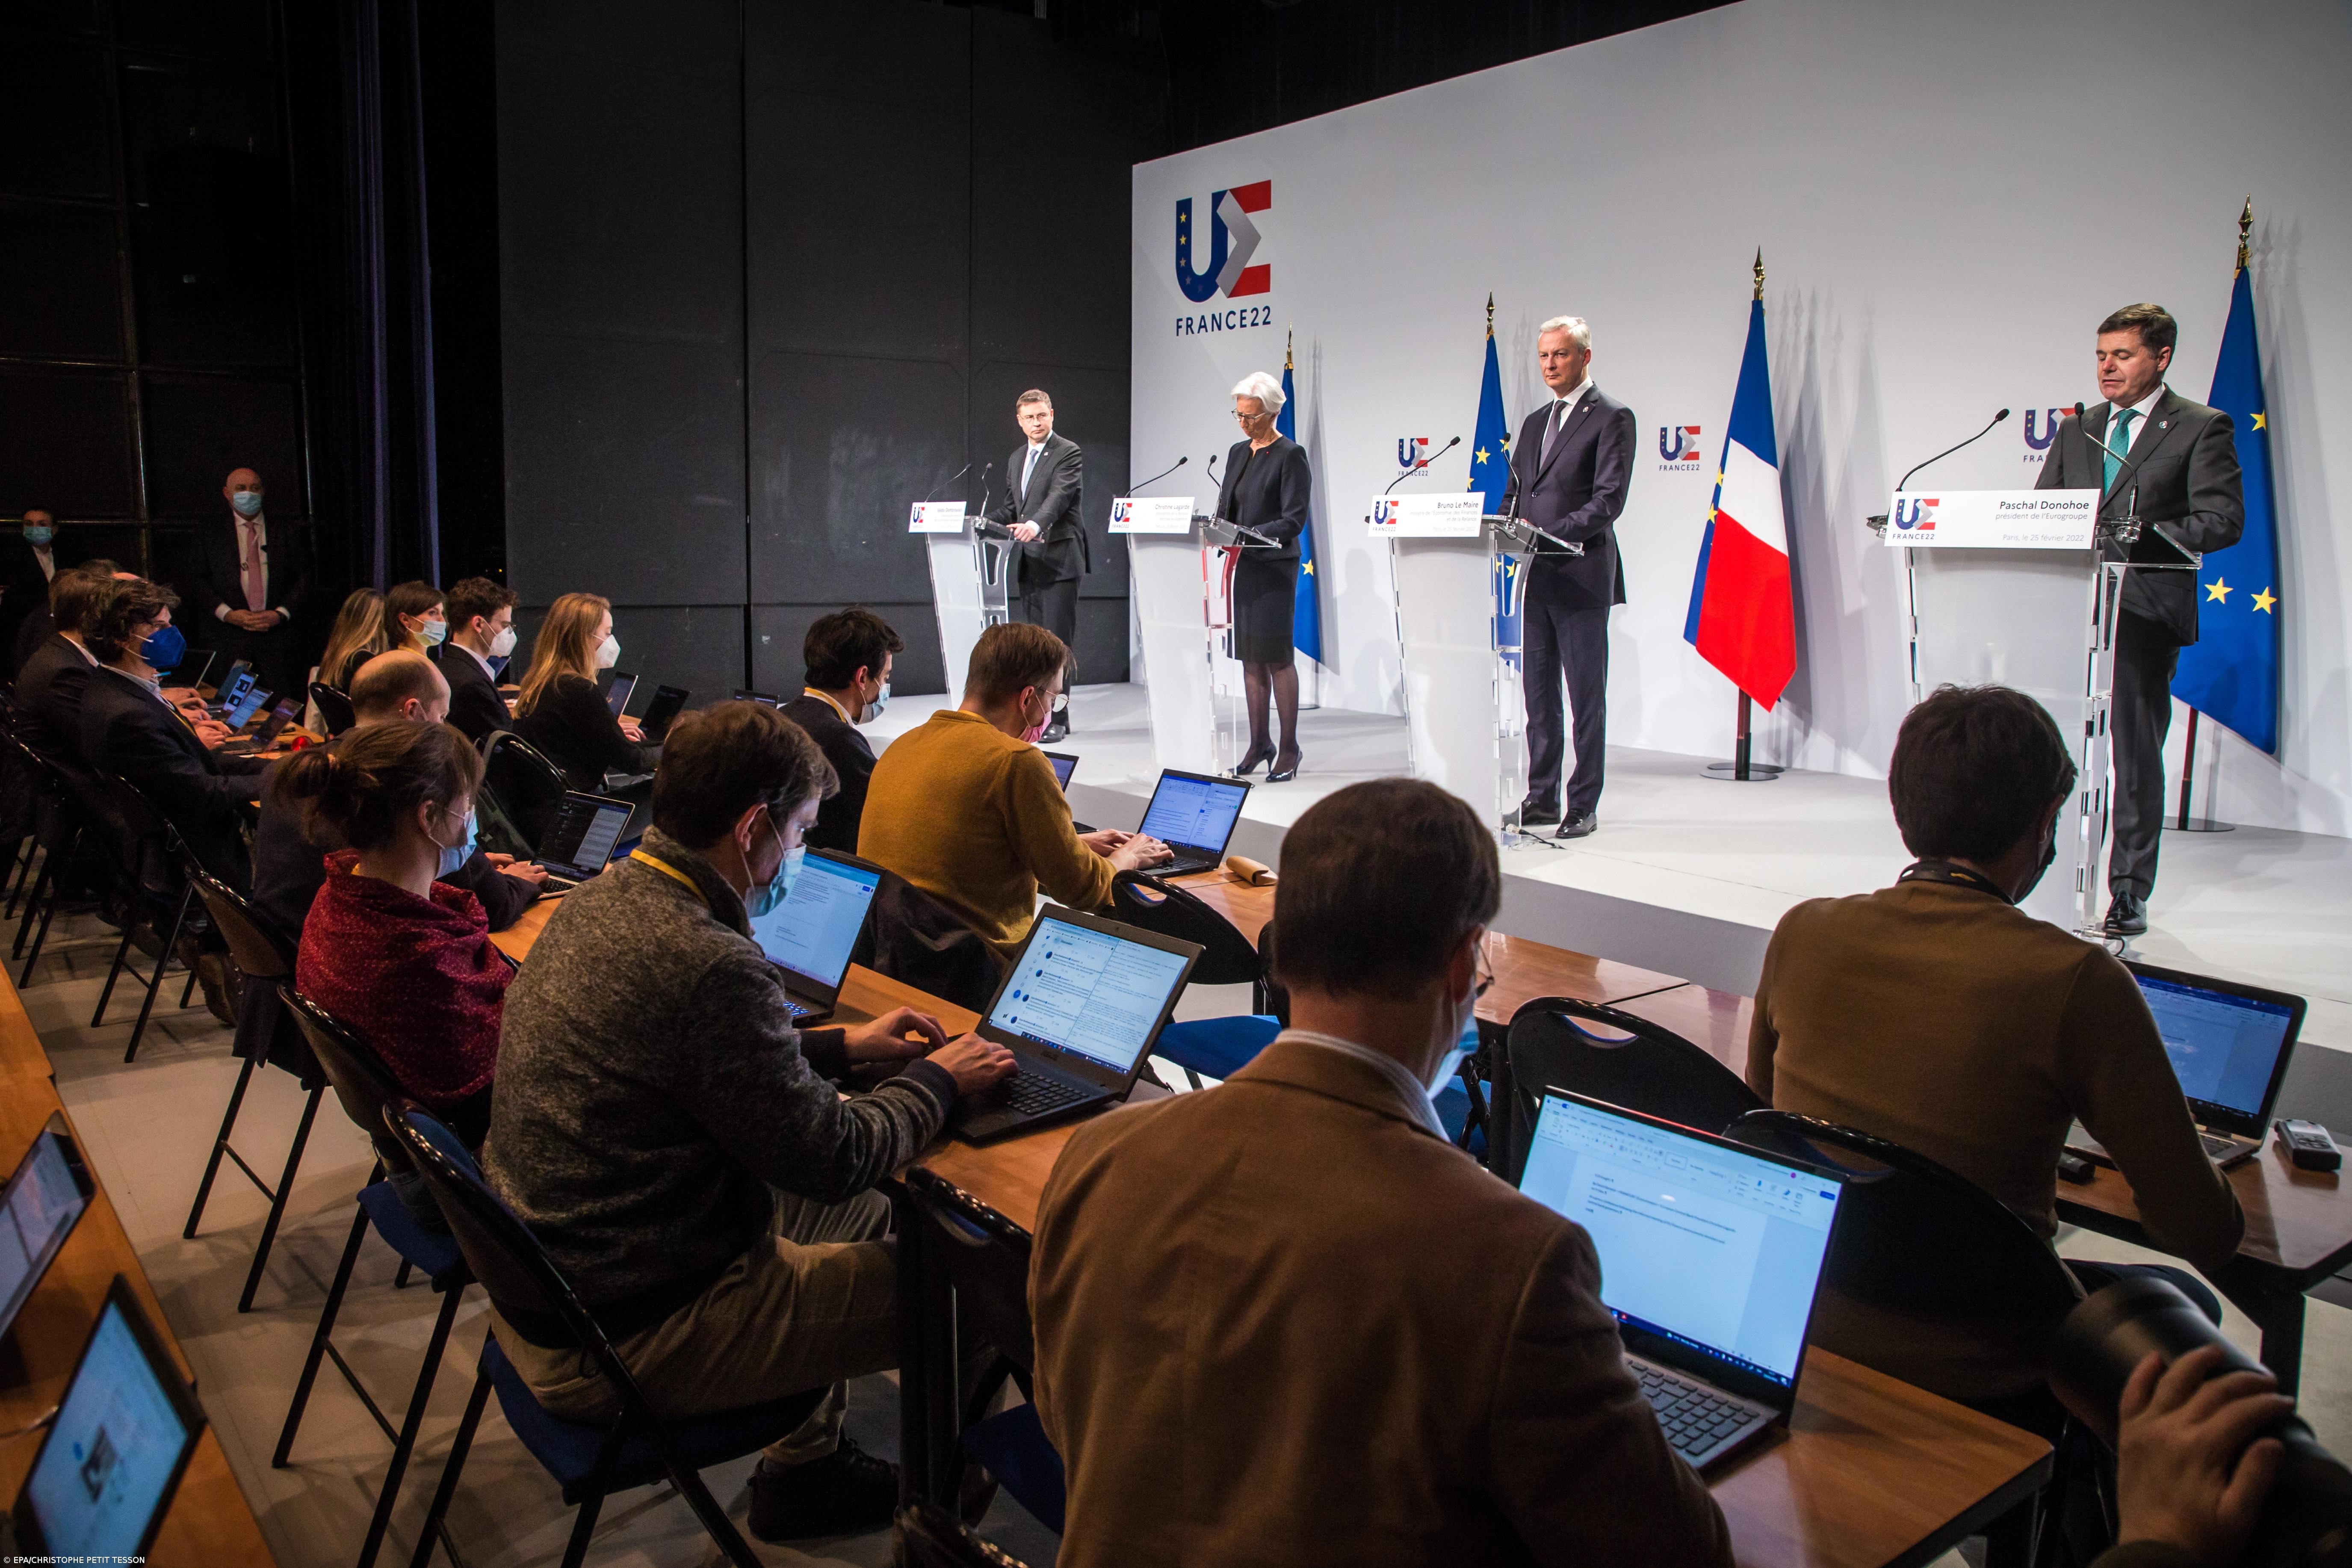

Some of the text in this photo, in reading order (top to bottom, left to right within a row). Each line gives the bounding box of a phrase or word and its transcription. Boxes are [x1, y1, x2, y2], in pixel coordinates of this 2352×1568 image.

[1176, 305, 1271, 337] FRANCE22
[2000, 500, 2089, 509] Paschal Donohoe
[1995, 512, 2028, 520] président
[2042, 513, 2088, 521] l'Eurogroupe
